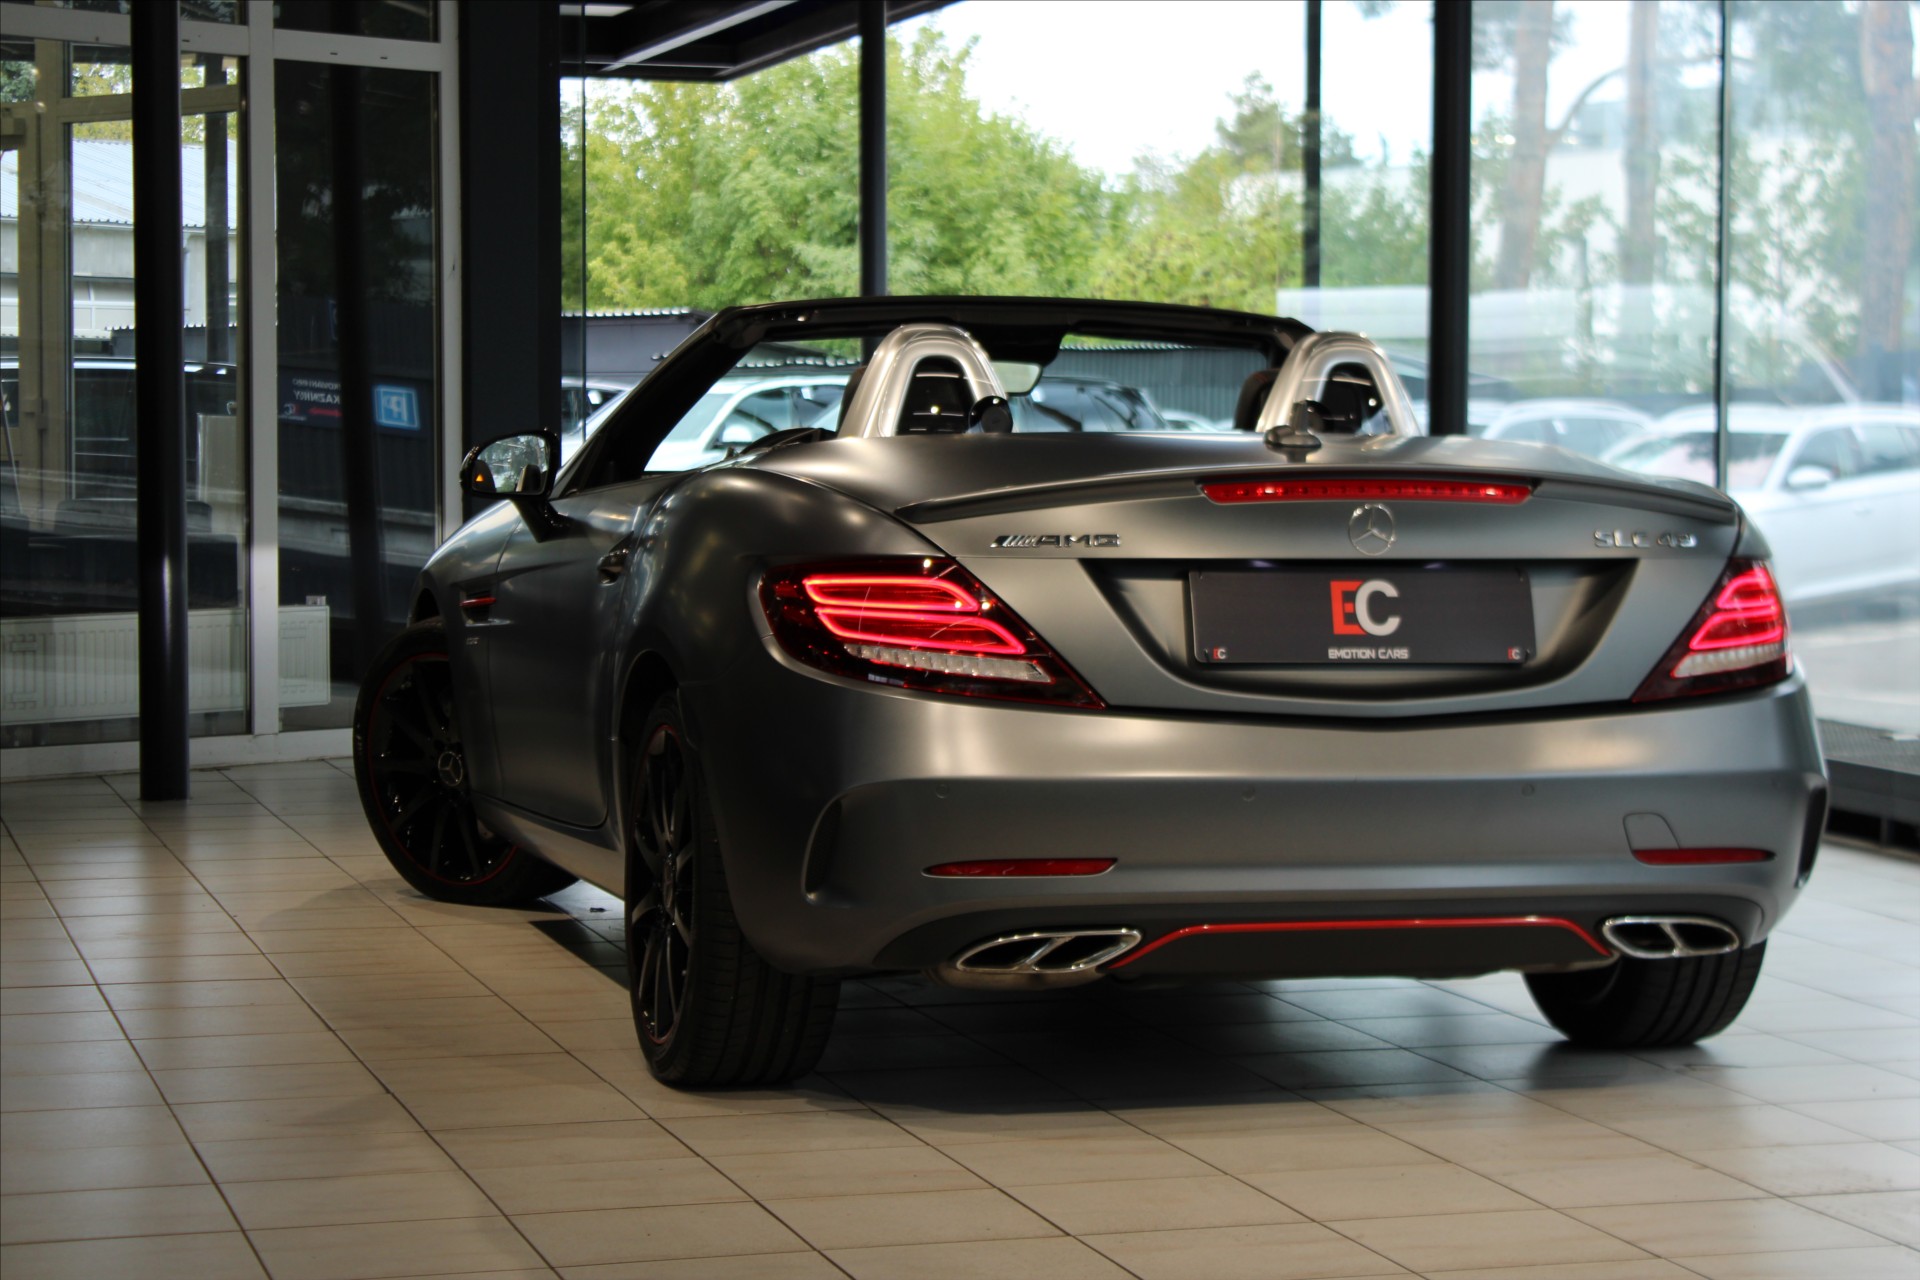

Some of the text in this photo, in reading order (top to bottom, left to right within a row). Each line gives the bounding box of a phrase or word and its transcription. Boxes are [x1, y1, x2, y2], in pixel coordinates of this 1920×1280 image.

[1034, 534, 1121, 548] AMG
[1594, 529, 1651, 549] SLC
[1330, 579, 1401, 636] EC
[1327, 648, 1409, 660] EMOTION CARS
